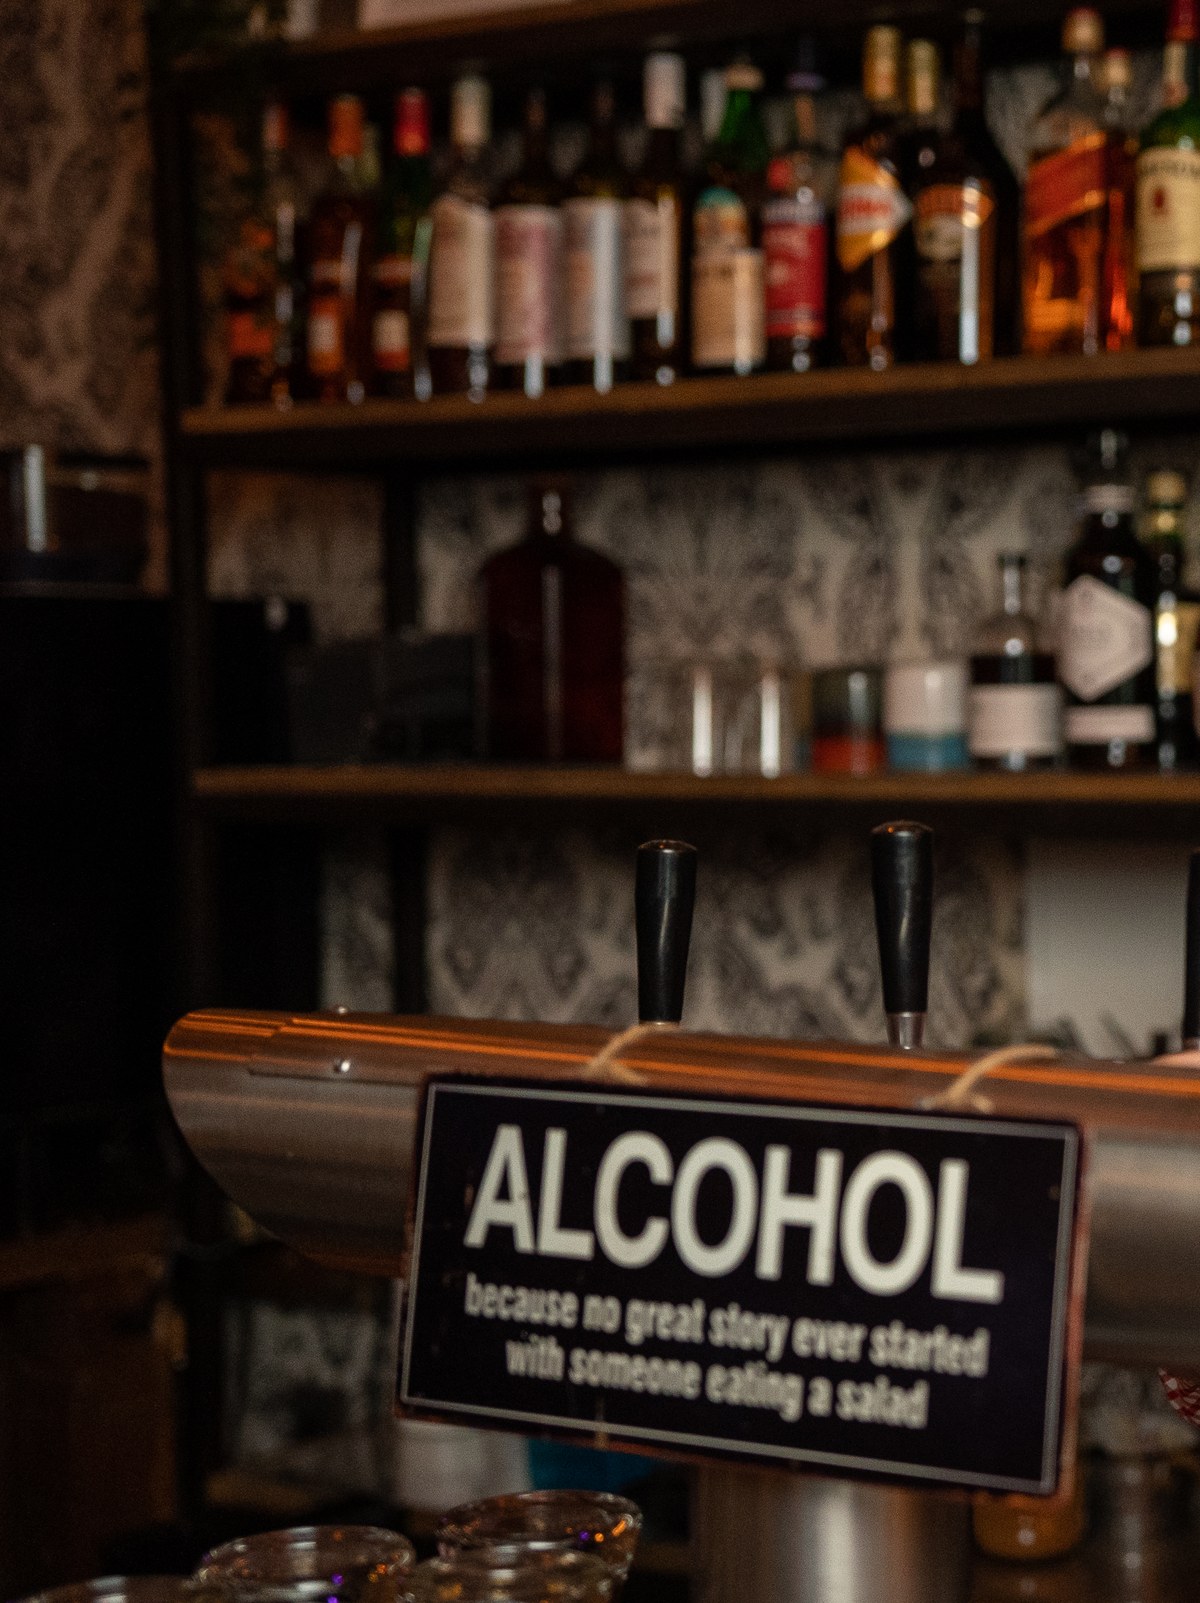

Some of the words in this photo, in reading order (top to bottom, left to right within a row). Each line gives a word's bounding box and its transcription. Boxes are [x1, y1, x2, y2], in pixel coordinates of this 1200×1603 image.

[464, 1124, 1004, 1303] ALCOHOL
[464, 1272, 579, 1329] because
[582, 1294, 622, 1334] no
[625, 1298, 706, 1345] great
[708, 1302, 790, 1363] story
[792, 1316, 868, 1363] ever
[868, 1319, 991, 1378] started
[505, 1333, 565, 1382] with
[568, 1347, 702, 1399] someone
[705, 1360, 805, 1422] eating
[807, 1376, 833, 1417] a
[835, 1374, 930, 1429] salad
